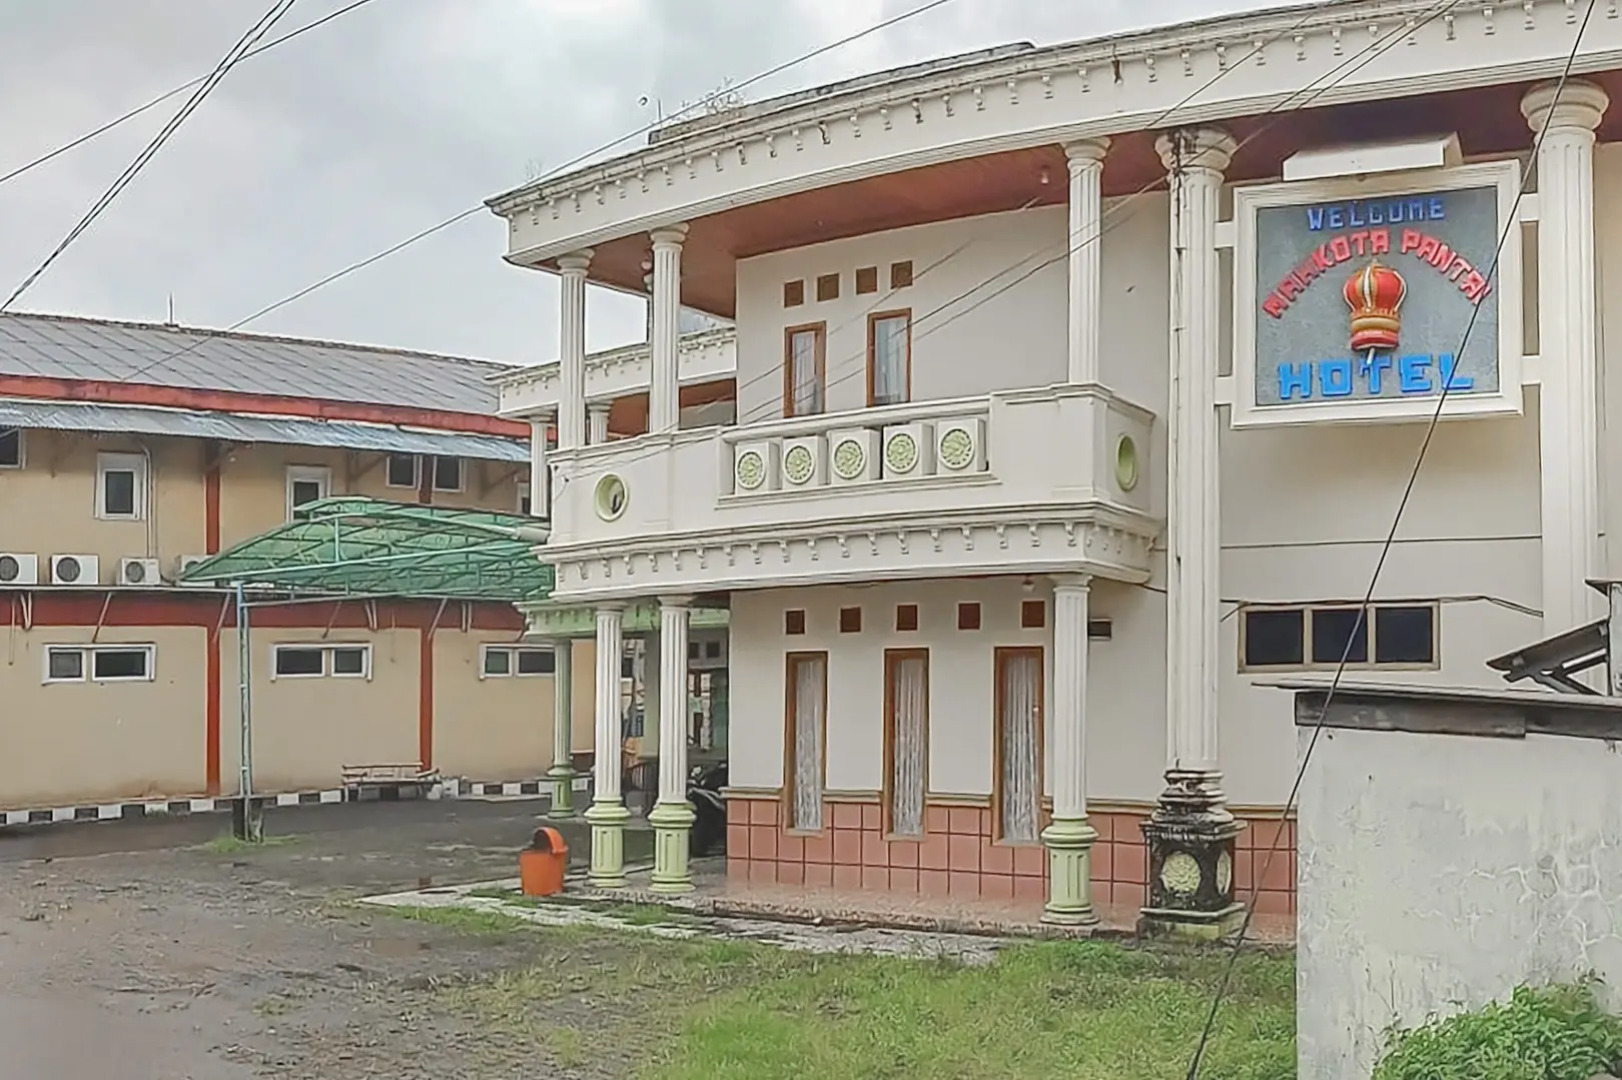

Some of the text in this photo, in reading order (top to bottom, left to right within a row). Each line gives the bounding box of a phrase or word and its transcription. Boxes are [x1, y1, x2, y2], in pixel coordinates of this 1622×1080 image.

[1307, 199, 1446, 231] WELCOME
[1262, 228, 1391, 318] MAHKOTA
[1278, 353, 1475, 399] HOTEL
